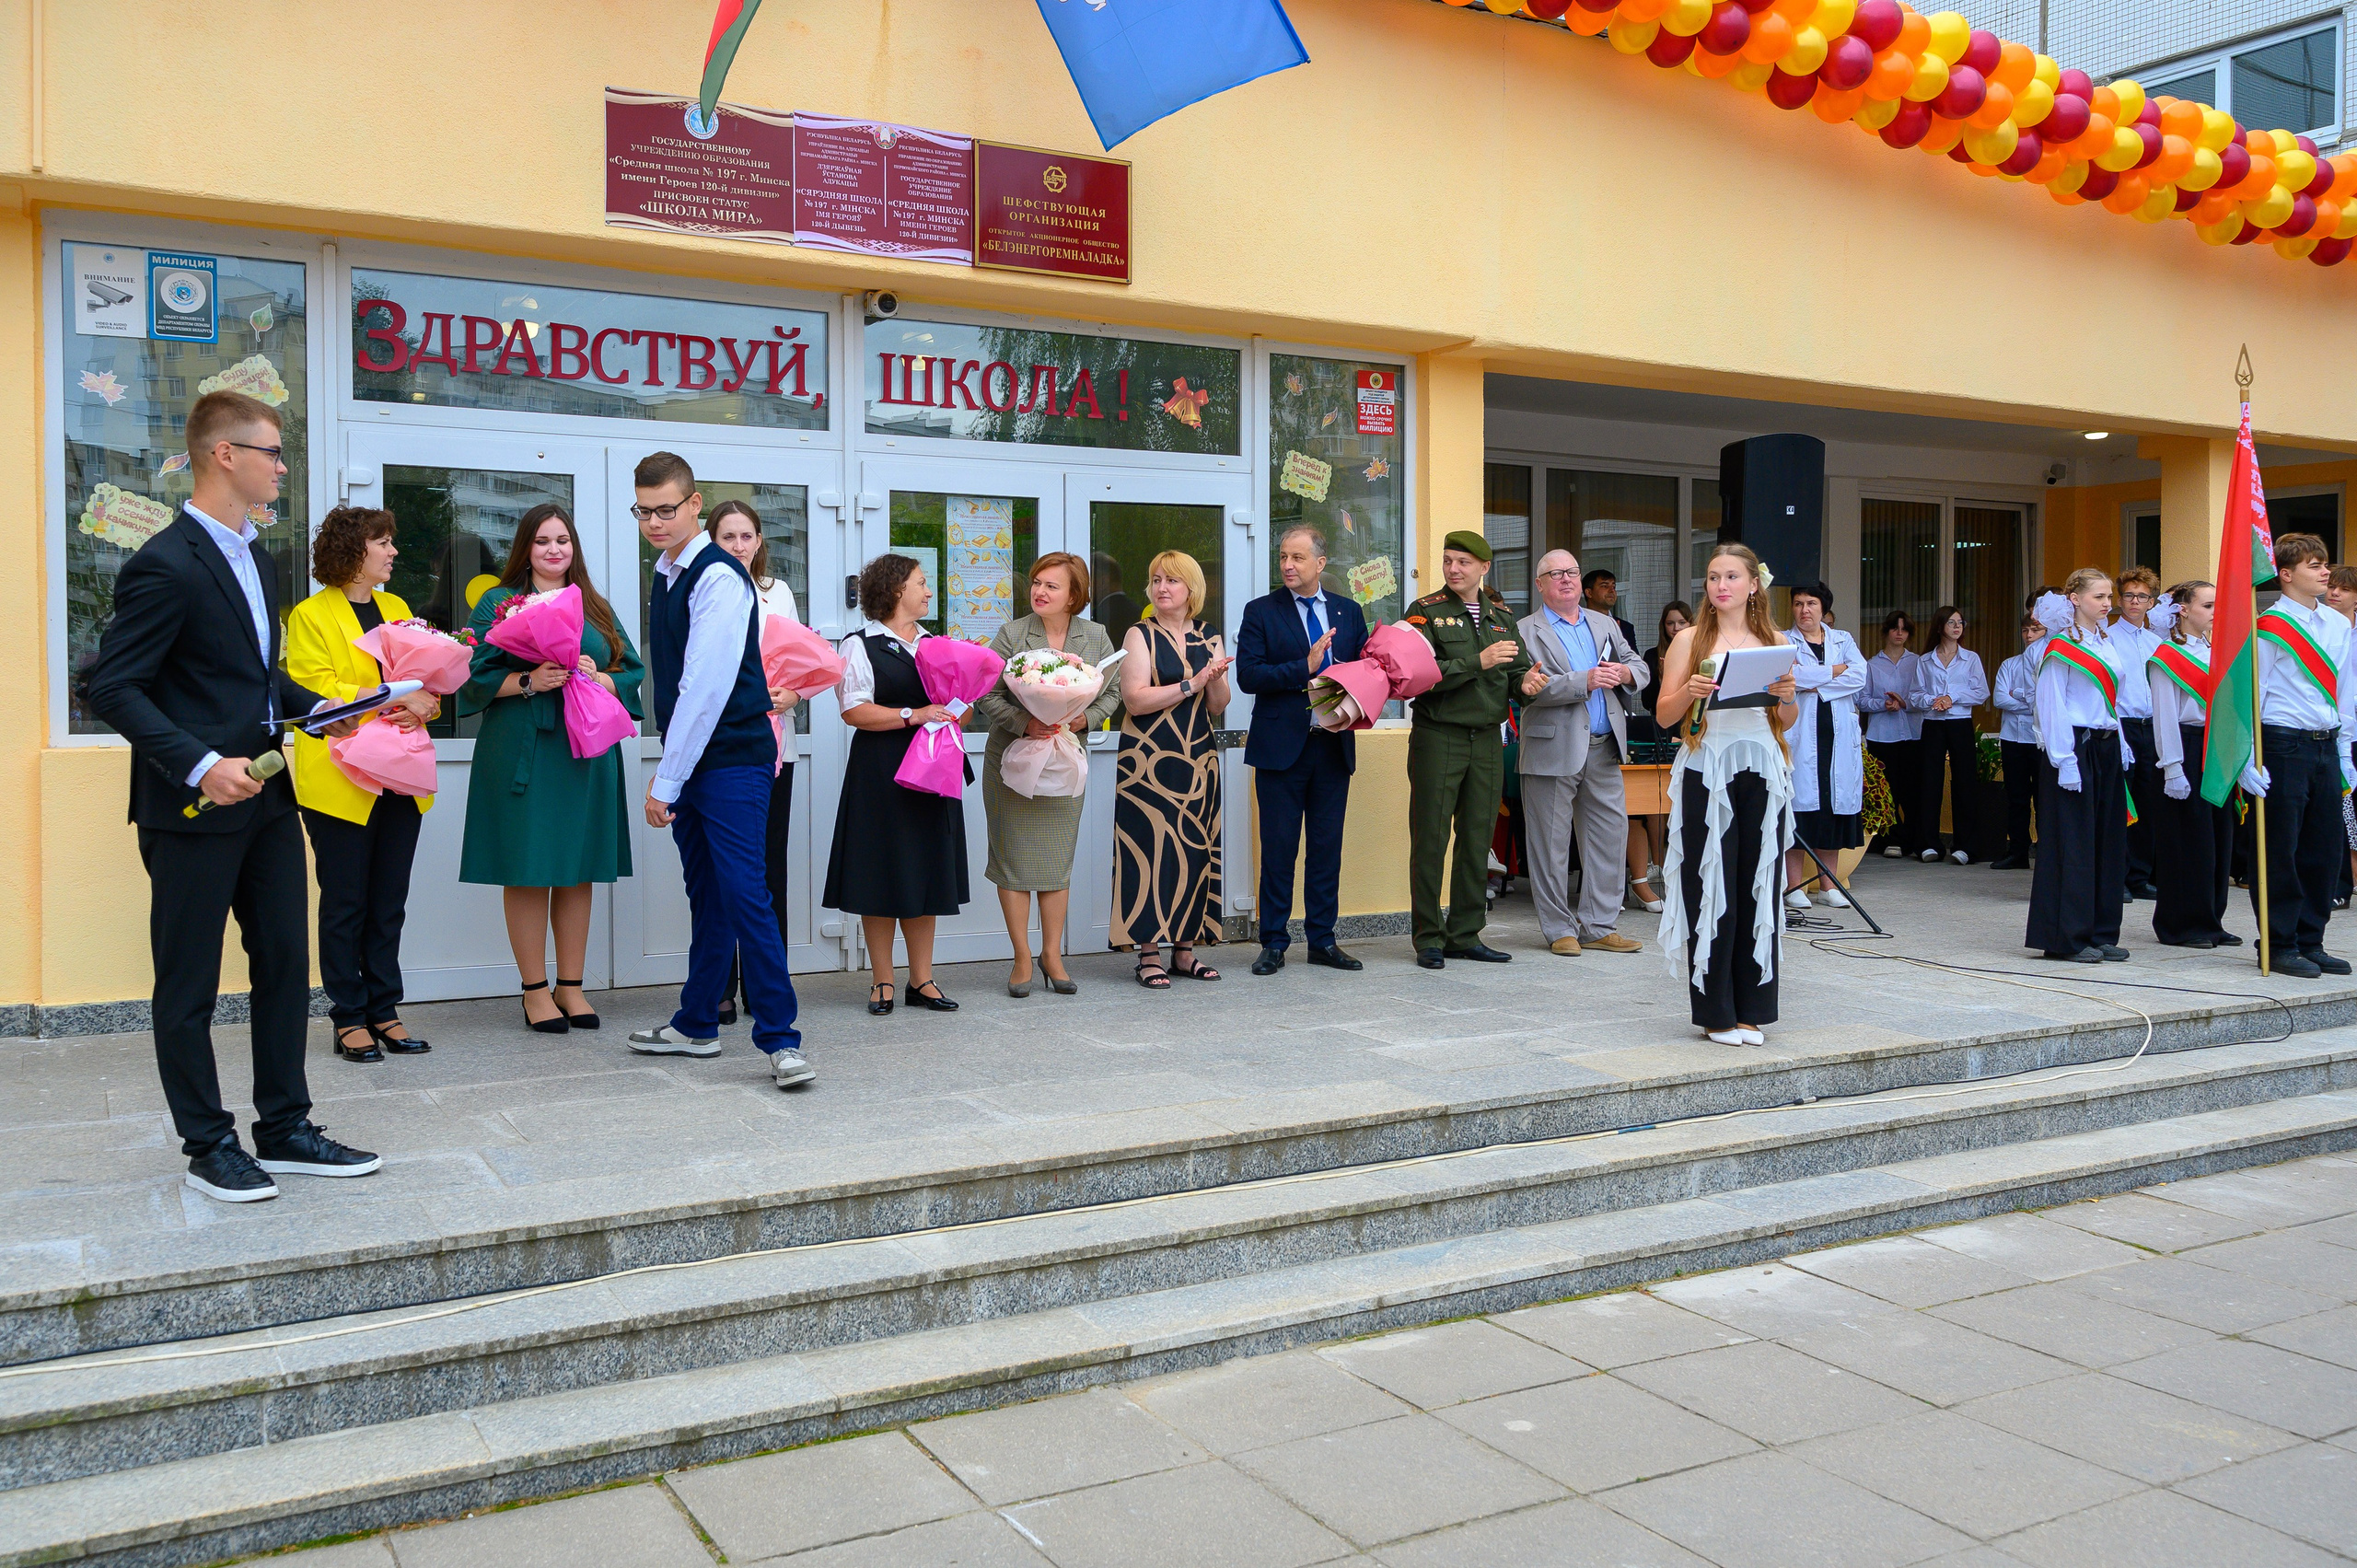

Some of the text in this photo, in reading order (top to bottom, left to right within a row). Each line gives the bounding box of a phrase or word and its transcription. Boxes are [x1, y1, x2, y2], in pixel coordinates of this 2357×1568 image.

[651, 135, 751, 157] ГОСУДАРСТВЕННОМУ
[842, 136, 872, 145] БЕЛАРУСЬ
[631, 144, 771, 169] УЧРЕЖДЕНИЮ ОБРАЗОВАНИЯ
[935, 149, 962, 158] БЕЛАРУСЬ
[609, 156, 661, 171] «Средняя
[665, 164, 700, 176] школа
[702, 168, 714, 178] №
[716, 168, 737, 180] 197
[749, 172, 791, 187] Минска
[621, 173, 780, 199] имени Героев 120-й дивизии»
[900, 175, 961, 189] ГОСУДАРСТВЕННОЕ
[909, 182, 952, 194] УЧРЕЖДЕНИЕ
[653, 190, 750, 210] ПРИСВОЕН СТАТУС
[795, 187, 884, 205] «СЯРЭДНЯЯ ШКОЛА
[908, 190, 953, 201] ОБРАЗОВАНИЯ
[639, 201, 763, 226] «ШКОЛА МИРА»
[814, 201, 828, 209] 197
[840, 203, 877, 215] МІНСКА
[888, 199, 970, 216] «СРЕДНЯЯ ШКОЛА
[1003, 195, 1106, 218] ШЕФСТВУЮЩАЯ
[816, 210, 862, 222] ІМЯ ГЕРОЯЎ
[903, 212, 915, 220] 197
[927, 214, 965, 226] МИНСКА
[1009, 212, 1099, 231] ОРГАНИЗАЦИЯ
[900, 220, 958, 233] ИМЕНИ ГЕРОЕВ
[918, 232, 958, 243] ДИВИЗИИ»
[988, 227, 1120, 250] ОТКРЫТОЕ АКЦИОНЕРНОЕ ОБЩЕСТВО
[982, 240, 1125, 266] «БЕЛЭНЕРГОРЕМНАЛАДКА»
[152, 255, 214, 269] МИЛИЦИЯ
[84, 274, 136, 284] ВНИМАНИЕ
[221, 366, 249, 384] Буду
[1360, 403, 1392, 416] ЗДЕСЬ
[1359, 424, 1393, 433] МИЛИЦИЮ
[1293, 453, 1321, 473] Вперёд
[1291, 466, 1324, 482] знаниям!
[120, 495, 166, 518] уже жду
[1360, 563, 1381, 575] Снова
[1364, 568, 1387, 584] школу!
